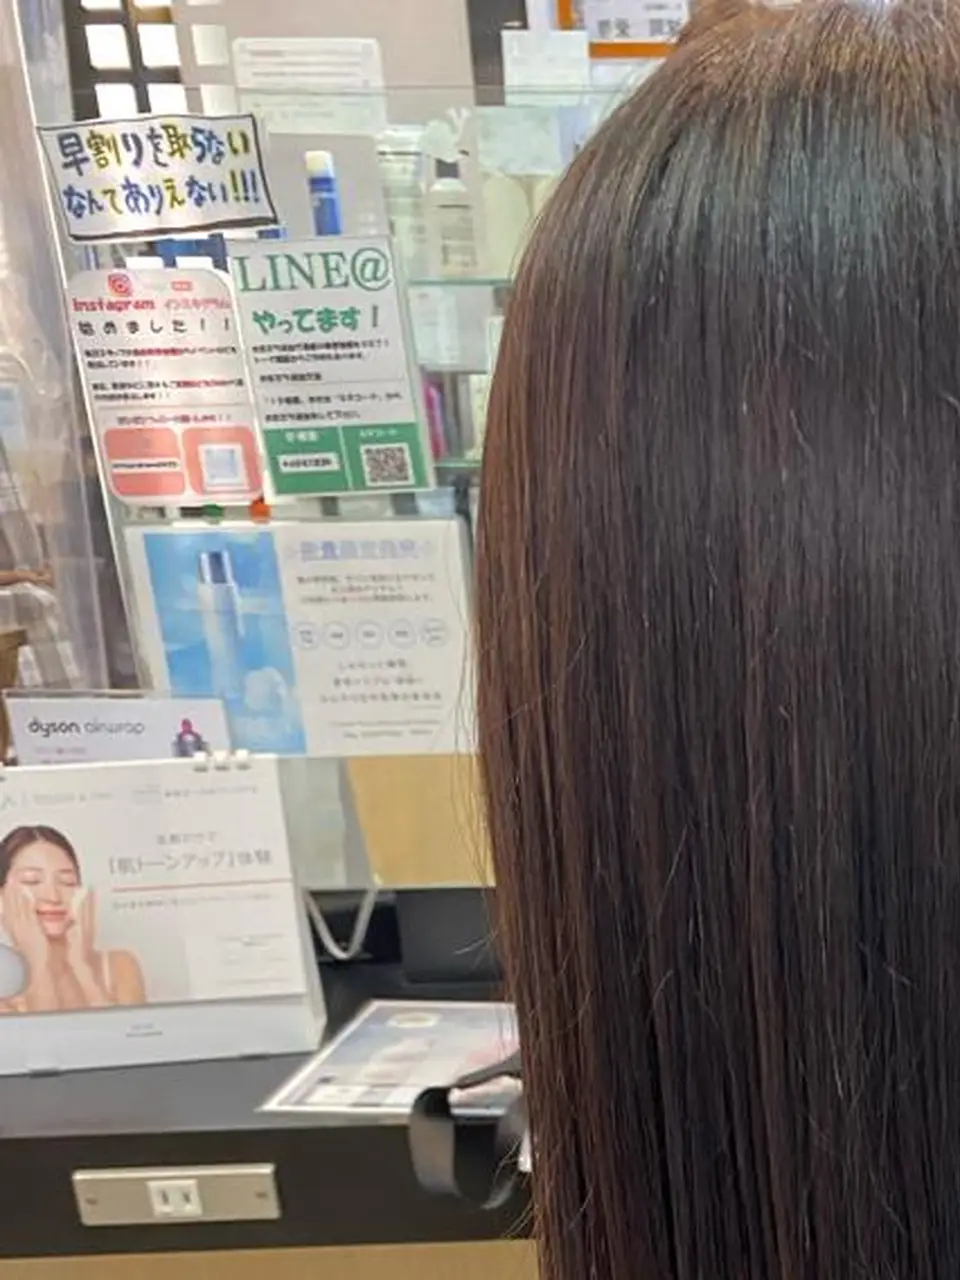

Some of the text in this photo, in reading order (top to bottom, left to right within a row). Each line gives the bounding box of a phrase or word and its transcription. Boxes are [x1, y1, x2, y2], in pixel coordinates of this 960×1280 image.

[57, 124, 250, 177] 早割りを取らない
[233, 247, 394, 292] LINE@
[72, 298, 156, 313] Instagram
[28, 715, 81, 738] dyson
